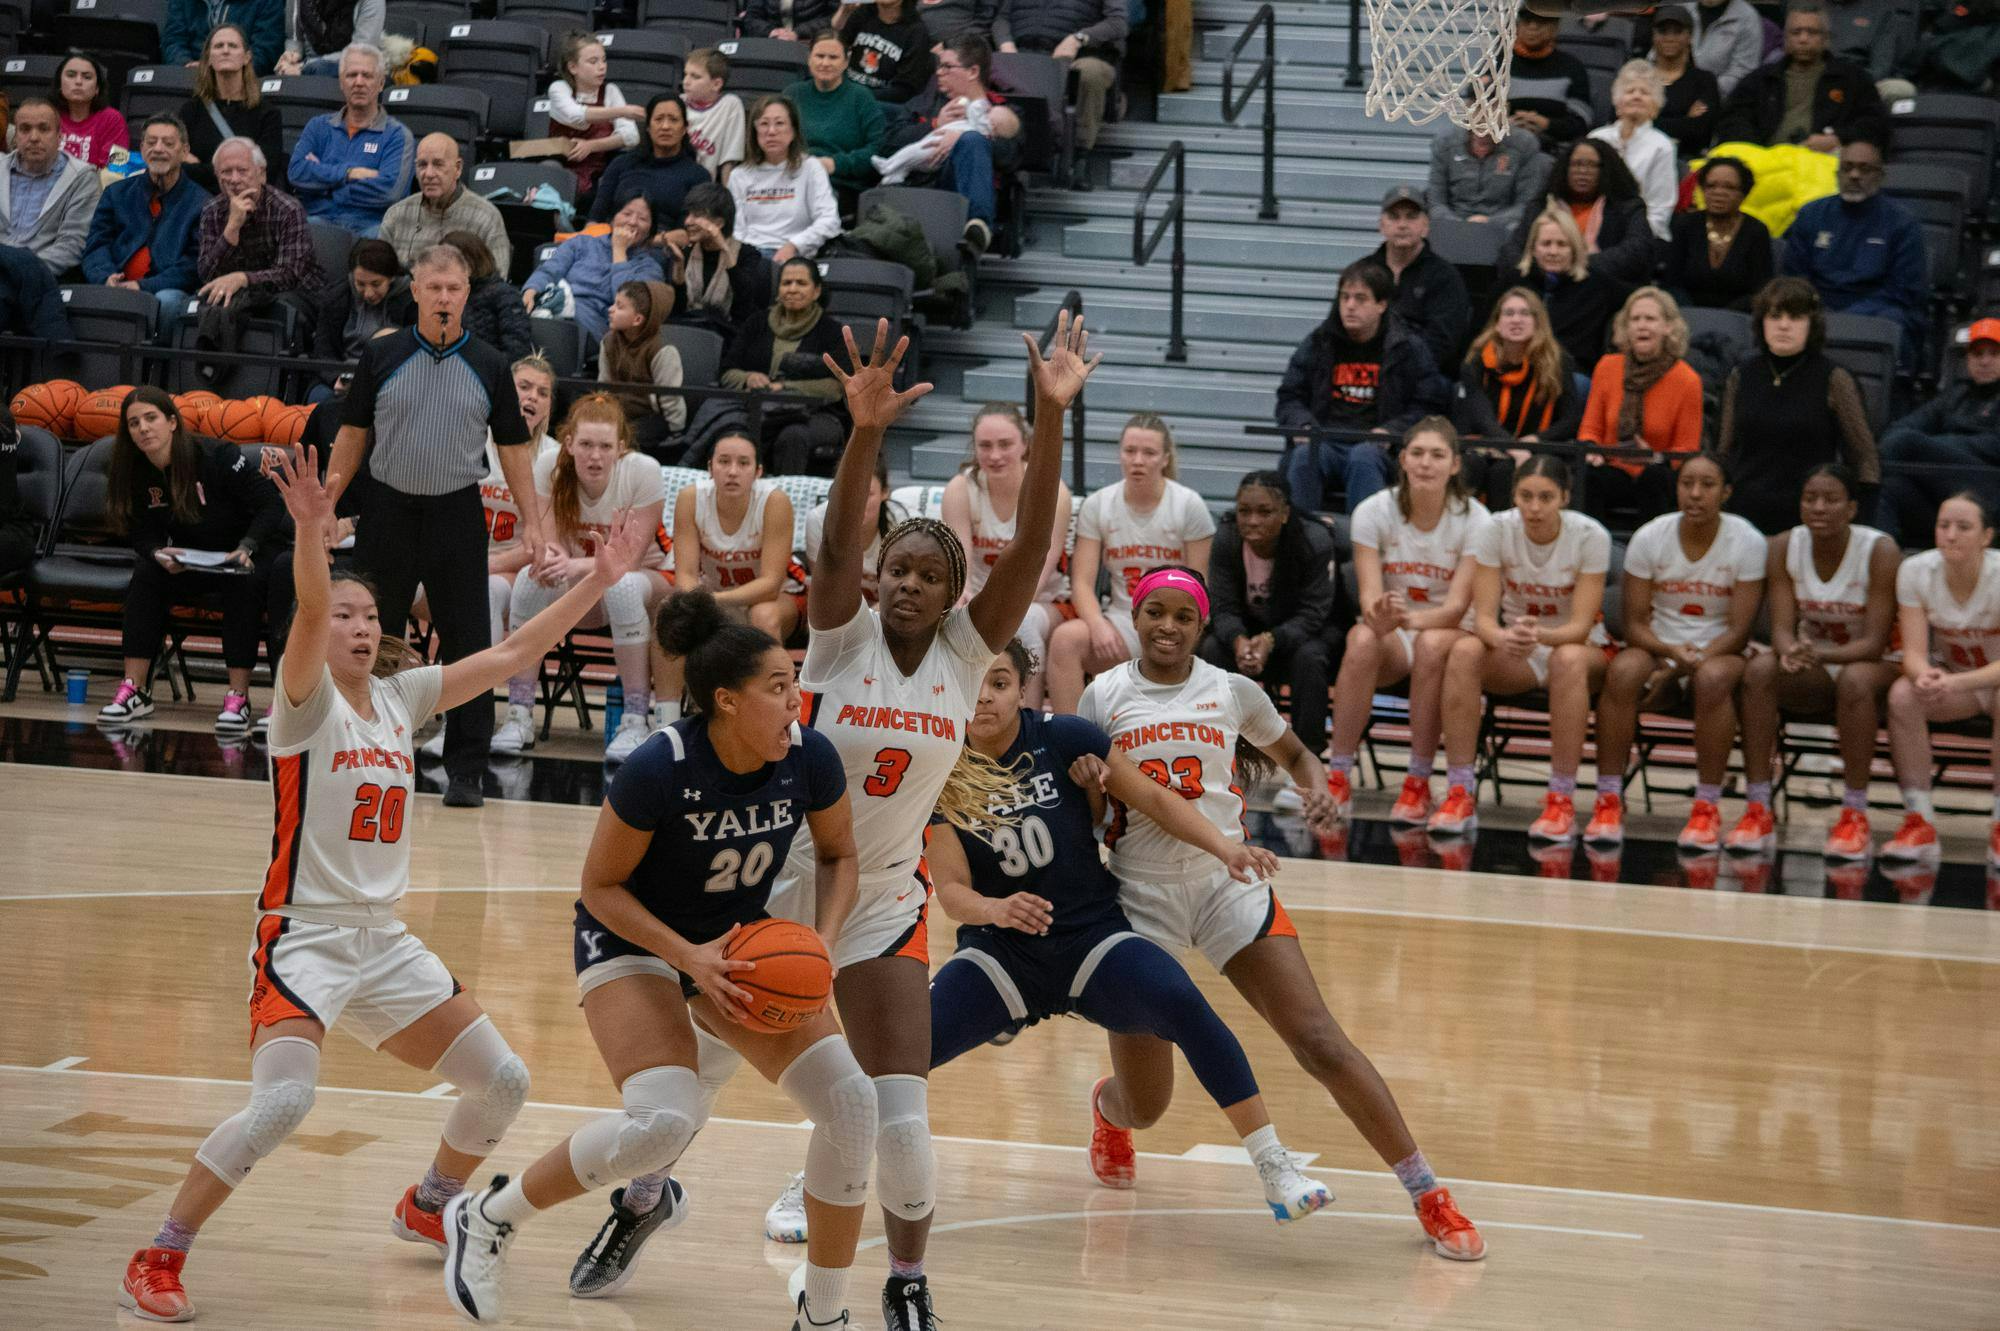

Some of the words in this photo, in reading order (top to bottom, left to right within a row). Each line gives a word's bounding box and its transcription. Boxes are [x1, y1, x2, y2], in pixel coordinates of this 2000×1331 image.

[1107, 544, 1182, 561] PRINCETON
[836, 704, 956, 742] PRINCETON
[331, 747, 414, 775] PRINCETO
[863, 747, 912, 798] 3
[348, 782, 408, 844] 20
[684, 799, 794, 841] YALE
[970, 772, 1059, 827] ALE
[704, 841, 774, 892] 20
[992, 815, 1054, 877] 30
[581, 930, 607, 961] Y
